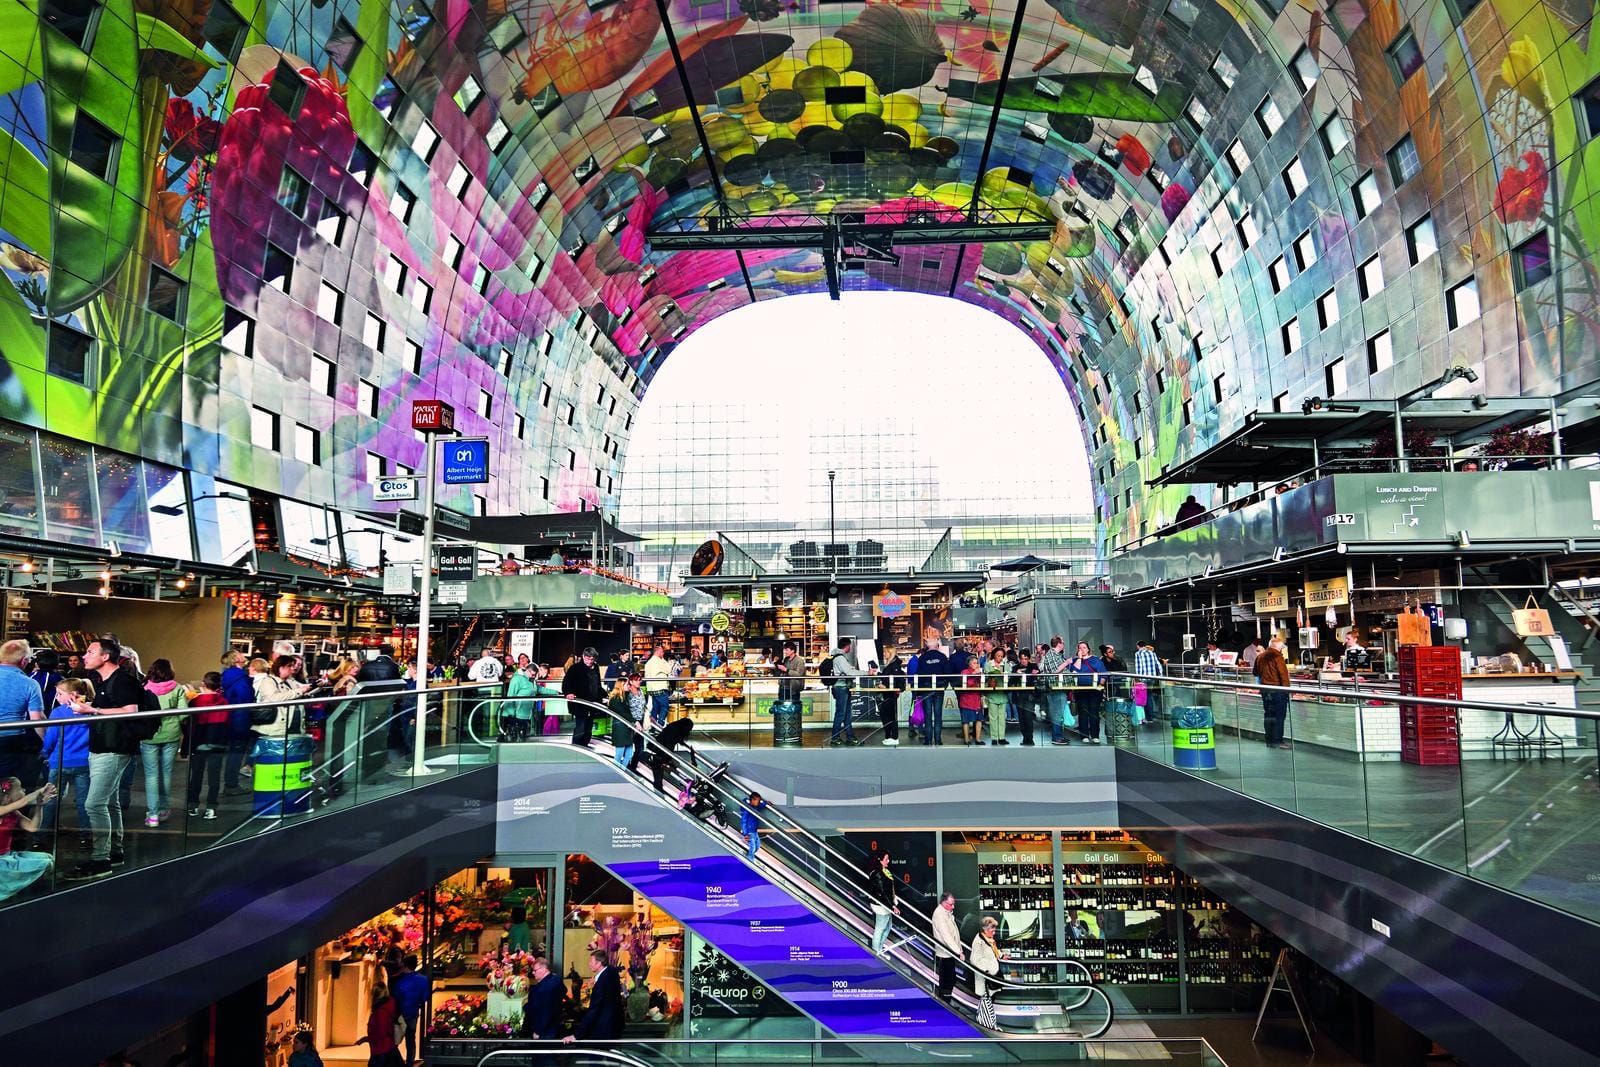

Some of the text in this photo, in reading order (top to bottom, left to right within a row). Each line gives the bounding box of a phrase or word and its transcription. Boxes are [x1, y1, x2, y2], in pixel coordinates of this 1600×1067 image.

[466, 466, 482, 475] Heijn
[1338, 514, 1354, 524] 17
[440, 556, 472, 565] Gall Gall
[612, 827, 628, 835] 1972
[1002, 853, 1036, 863] Gall Gall
[1084, 853, 1119, 863] Gall Gall
[706, 886, 722, 894] 1940
[832, 980, 848, 989] 1900
